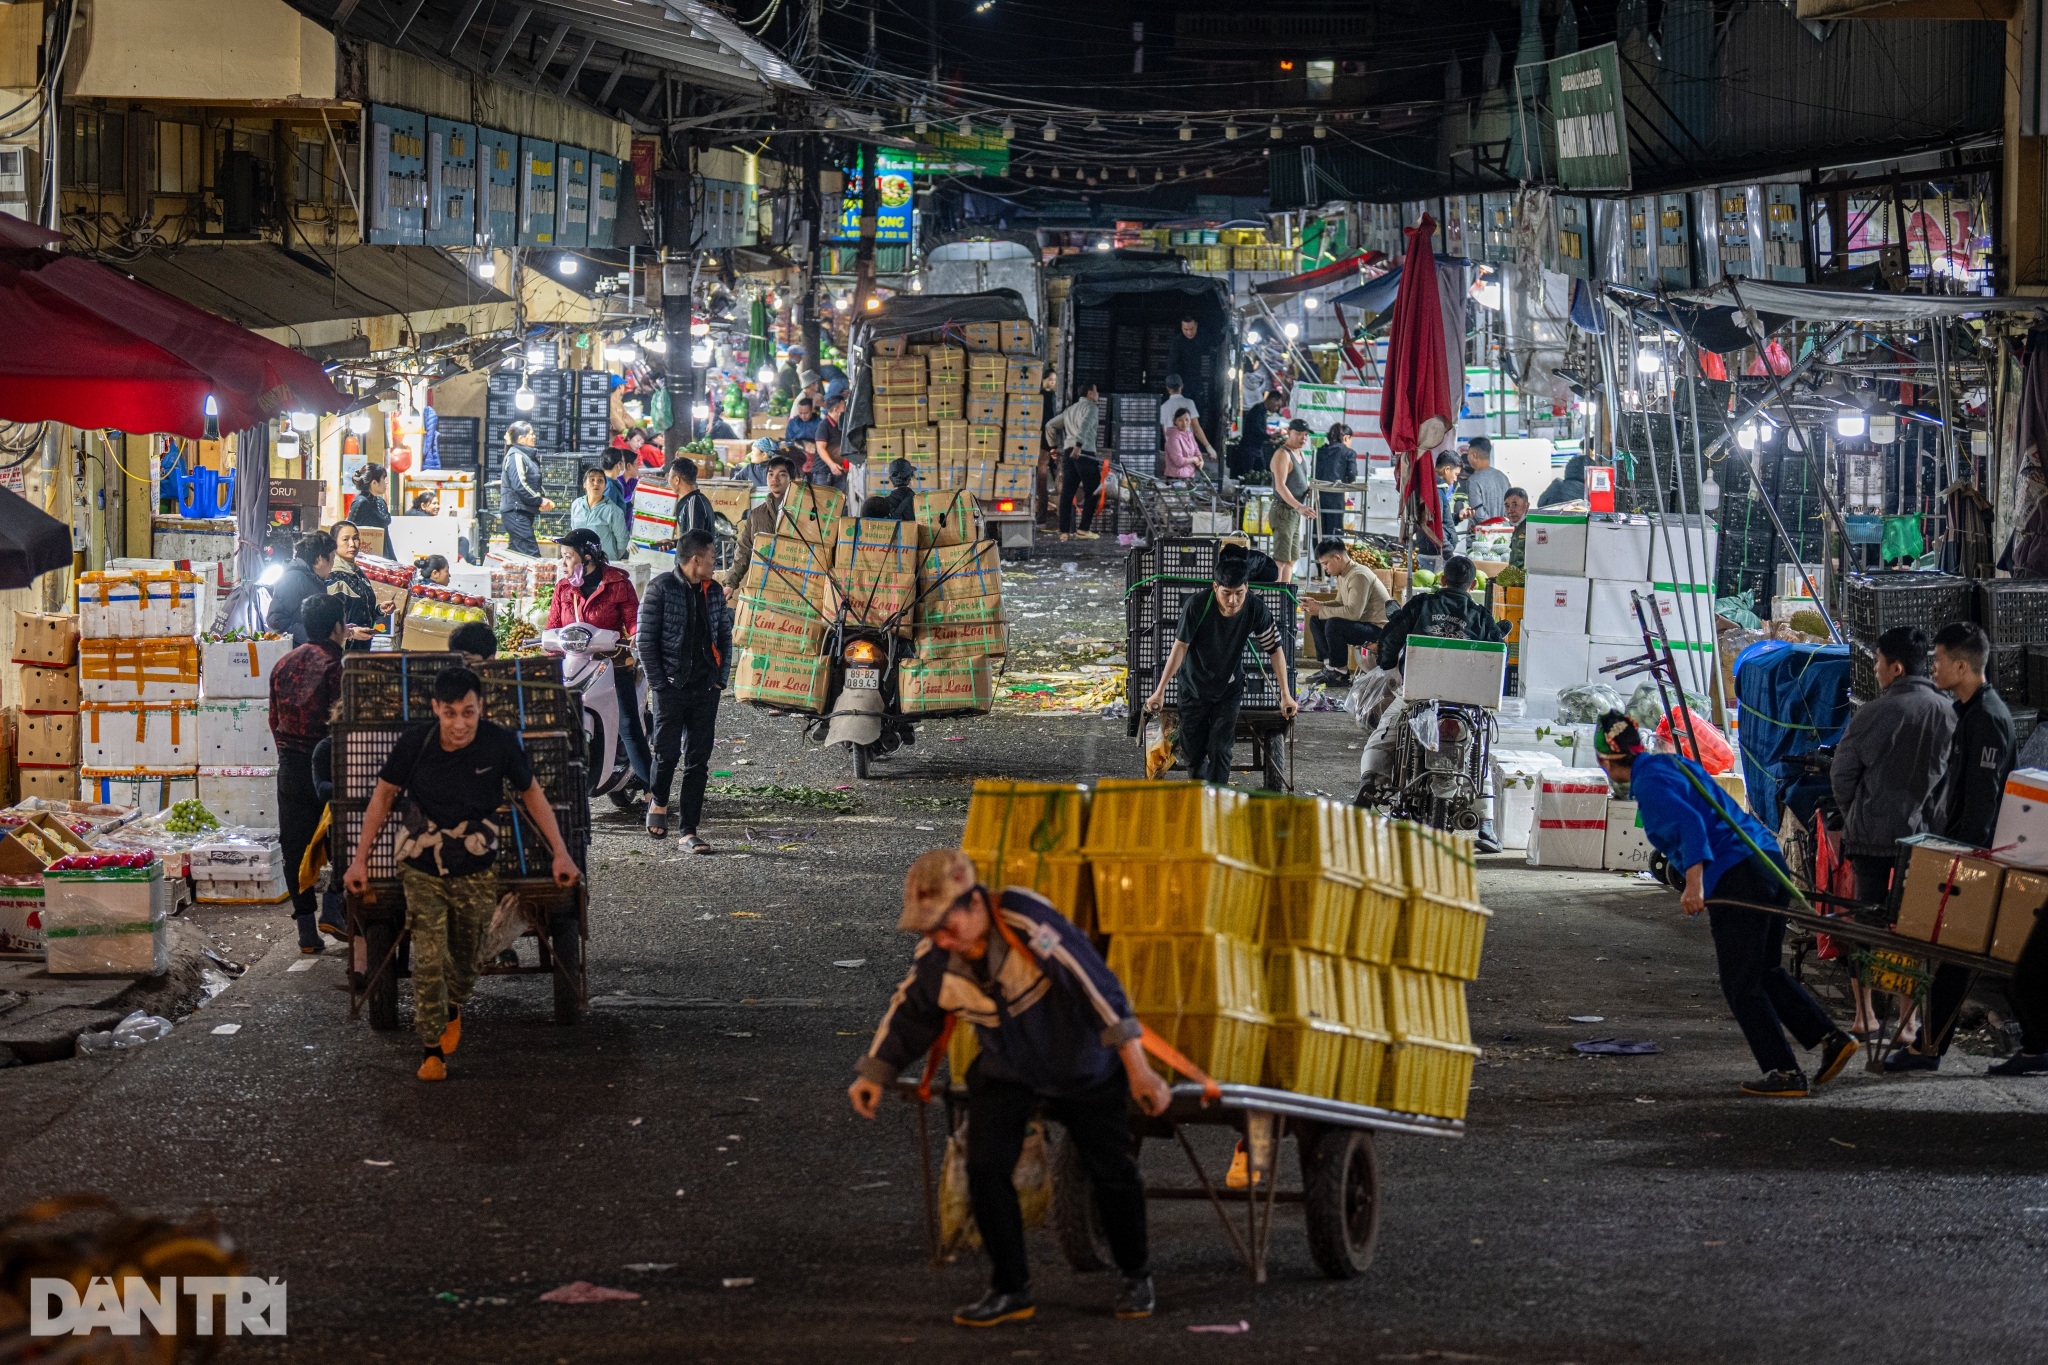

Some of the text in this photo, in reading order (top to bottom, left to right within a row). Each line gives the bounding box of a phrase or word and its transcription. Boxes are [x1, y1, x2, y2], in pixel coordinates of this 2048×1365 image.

[752, 613, 776, 629] Kim
[1431, 613, 1467, 630] ROCAWEAR
[931, 626, 958, 641] Kim
[752, 673, 780, 689] Kim
[851, 670, 875, 679] 89-B2
[847, 679, 877, 688] 089.43
[913, 681, 942, 695] Kim
[1981, 746, 1998, 763] NT
